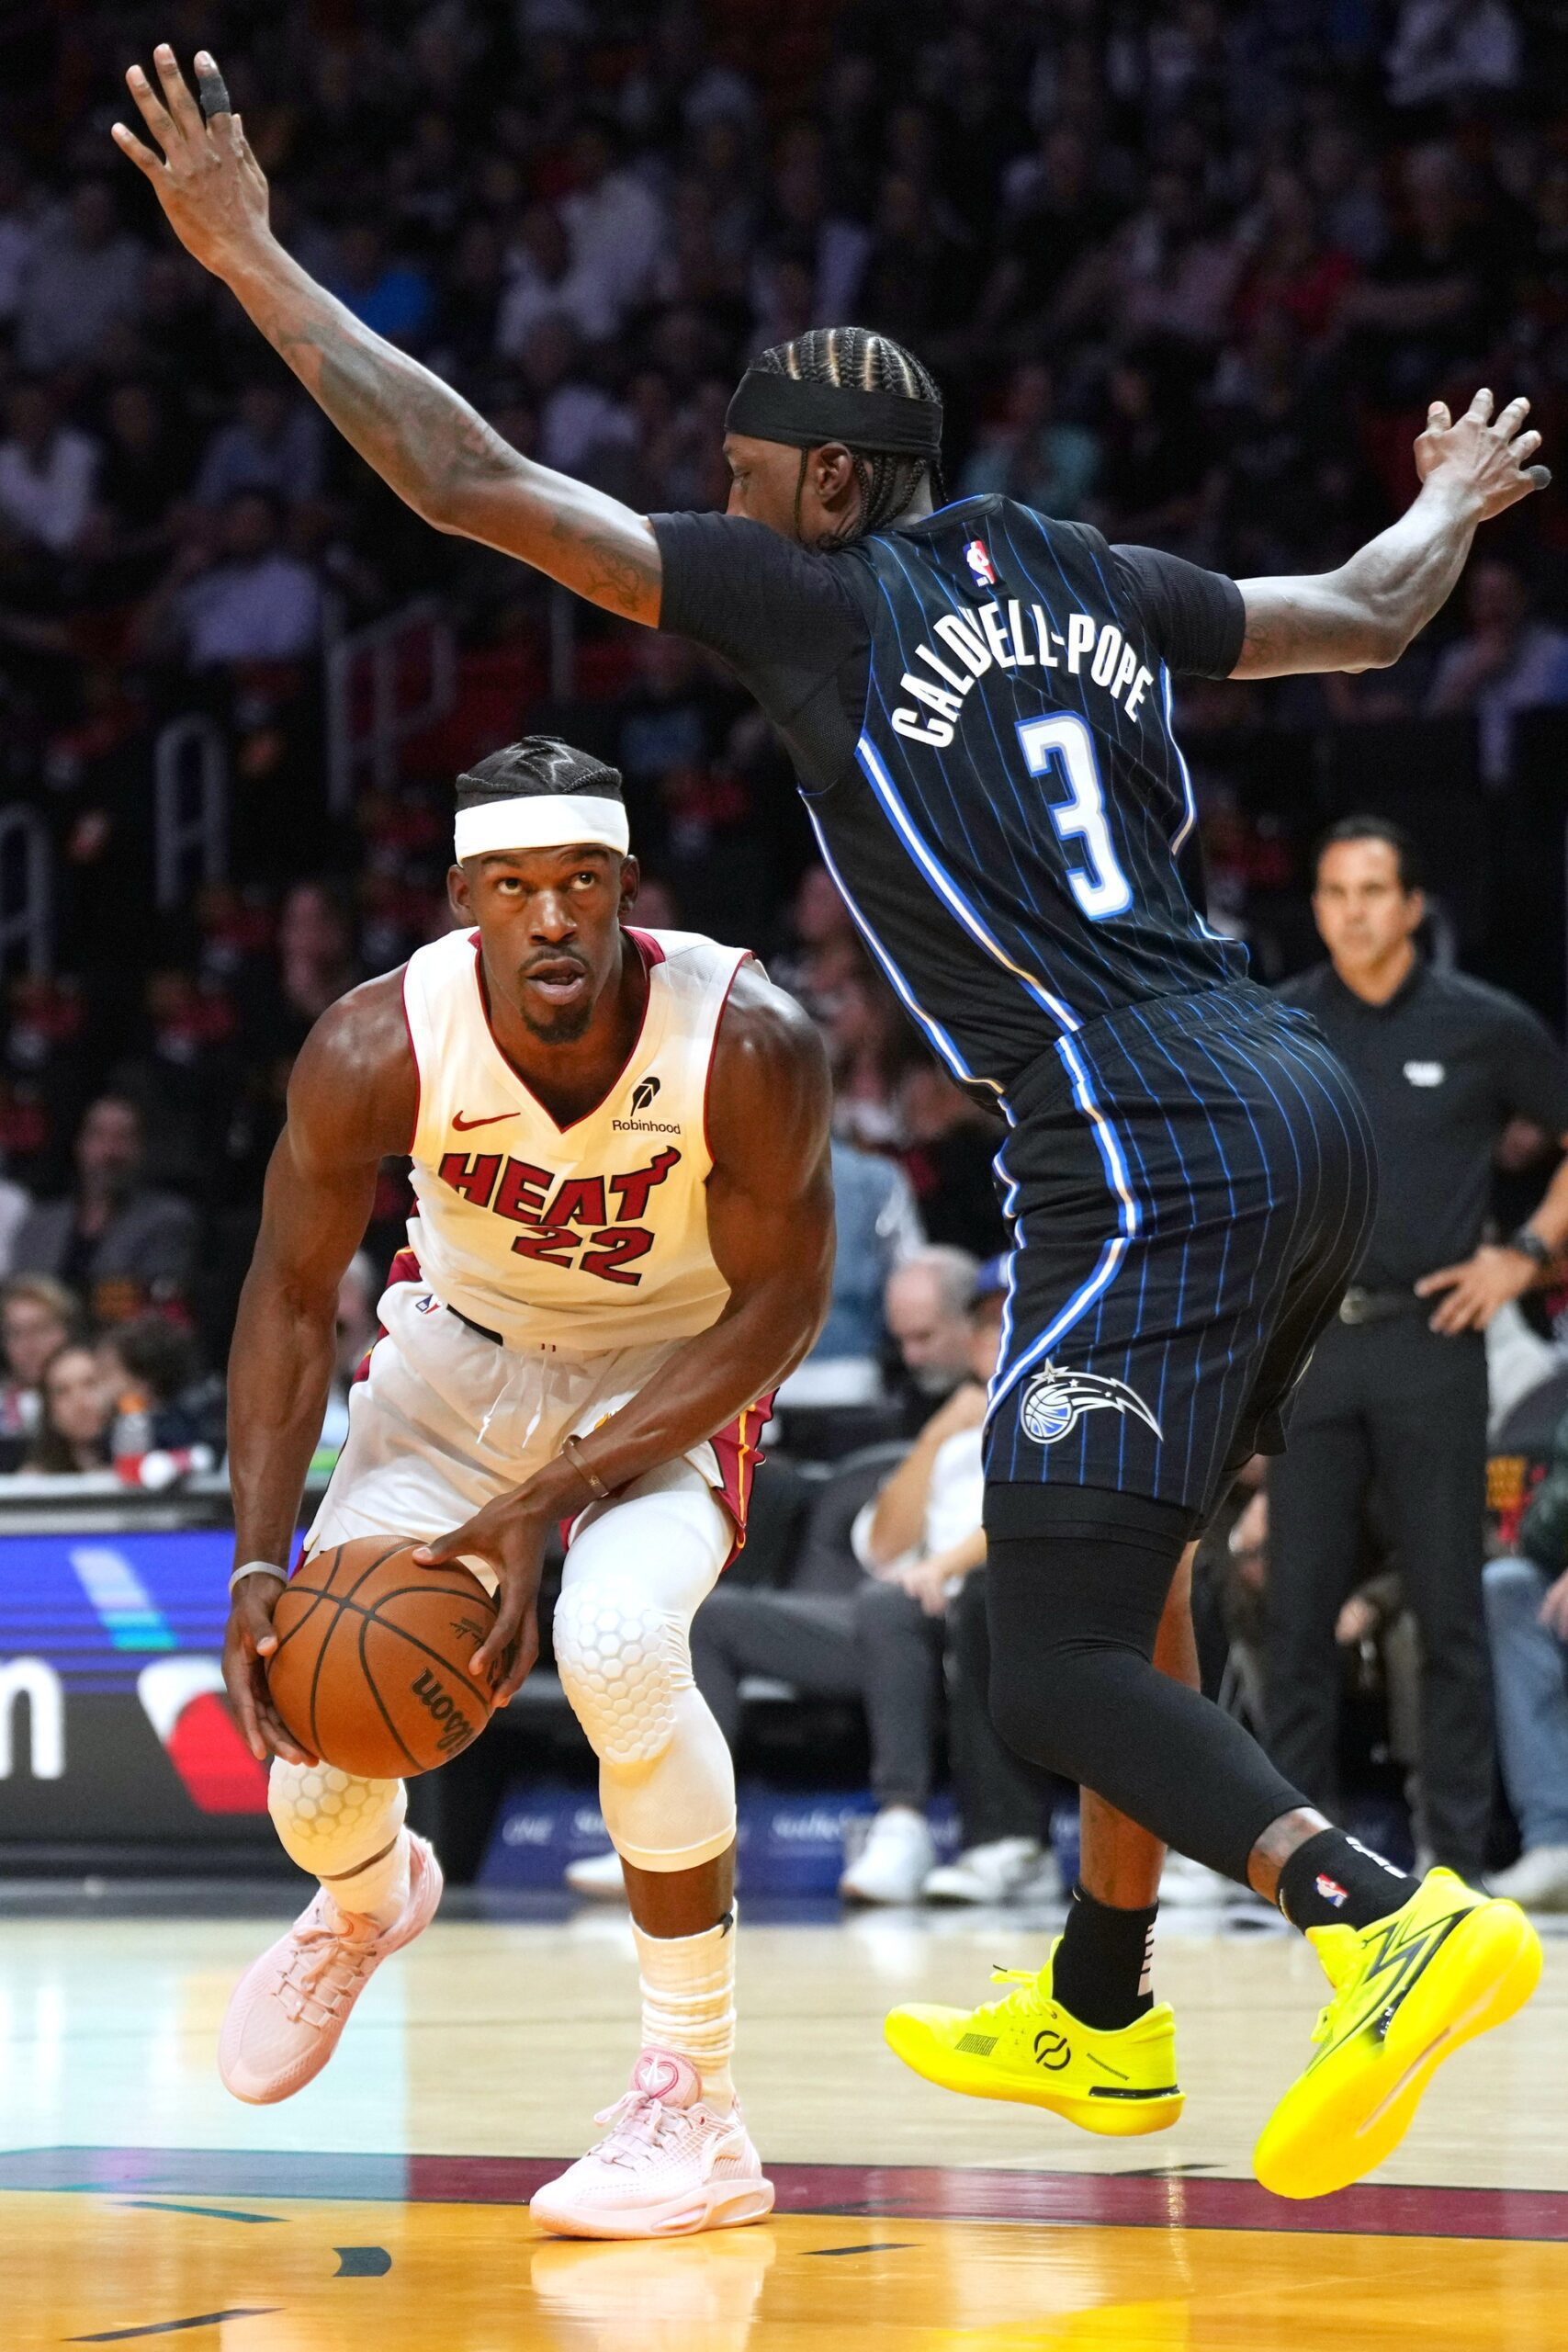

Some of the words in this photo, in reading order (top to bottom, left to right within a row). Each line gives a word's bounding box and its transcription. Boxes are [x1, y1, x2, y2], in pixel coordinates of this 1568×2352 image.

[1014, 710, 1133, 921] 3
[612, 1119, 682, 1135] Robinhood
[437, 1145, 682, 1227] HEAT
[511, 1225, 655, 1286] 22
[412, 1667, 475, 1758] ilson
